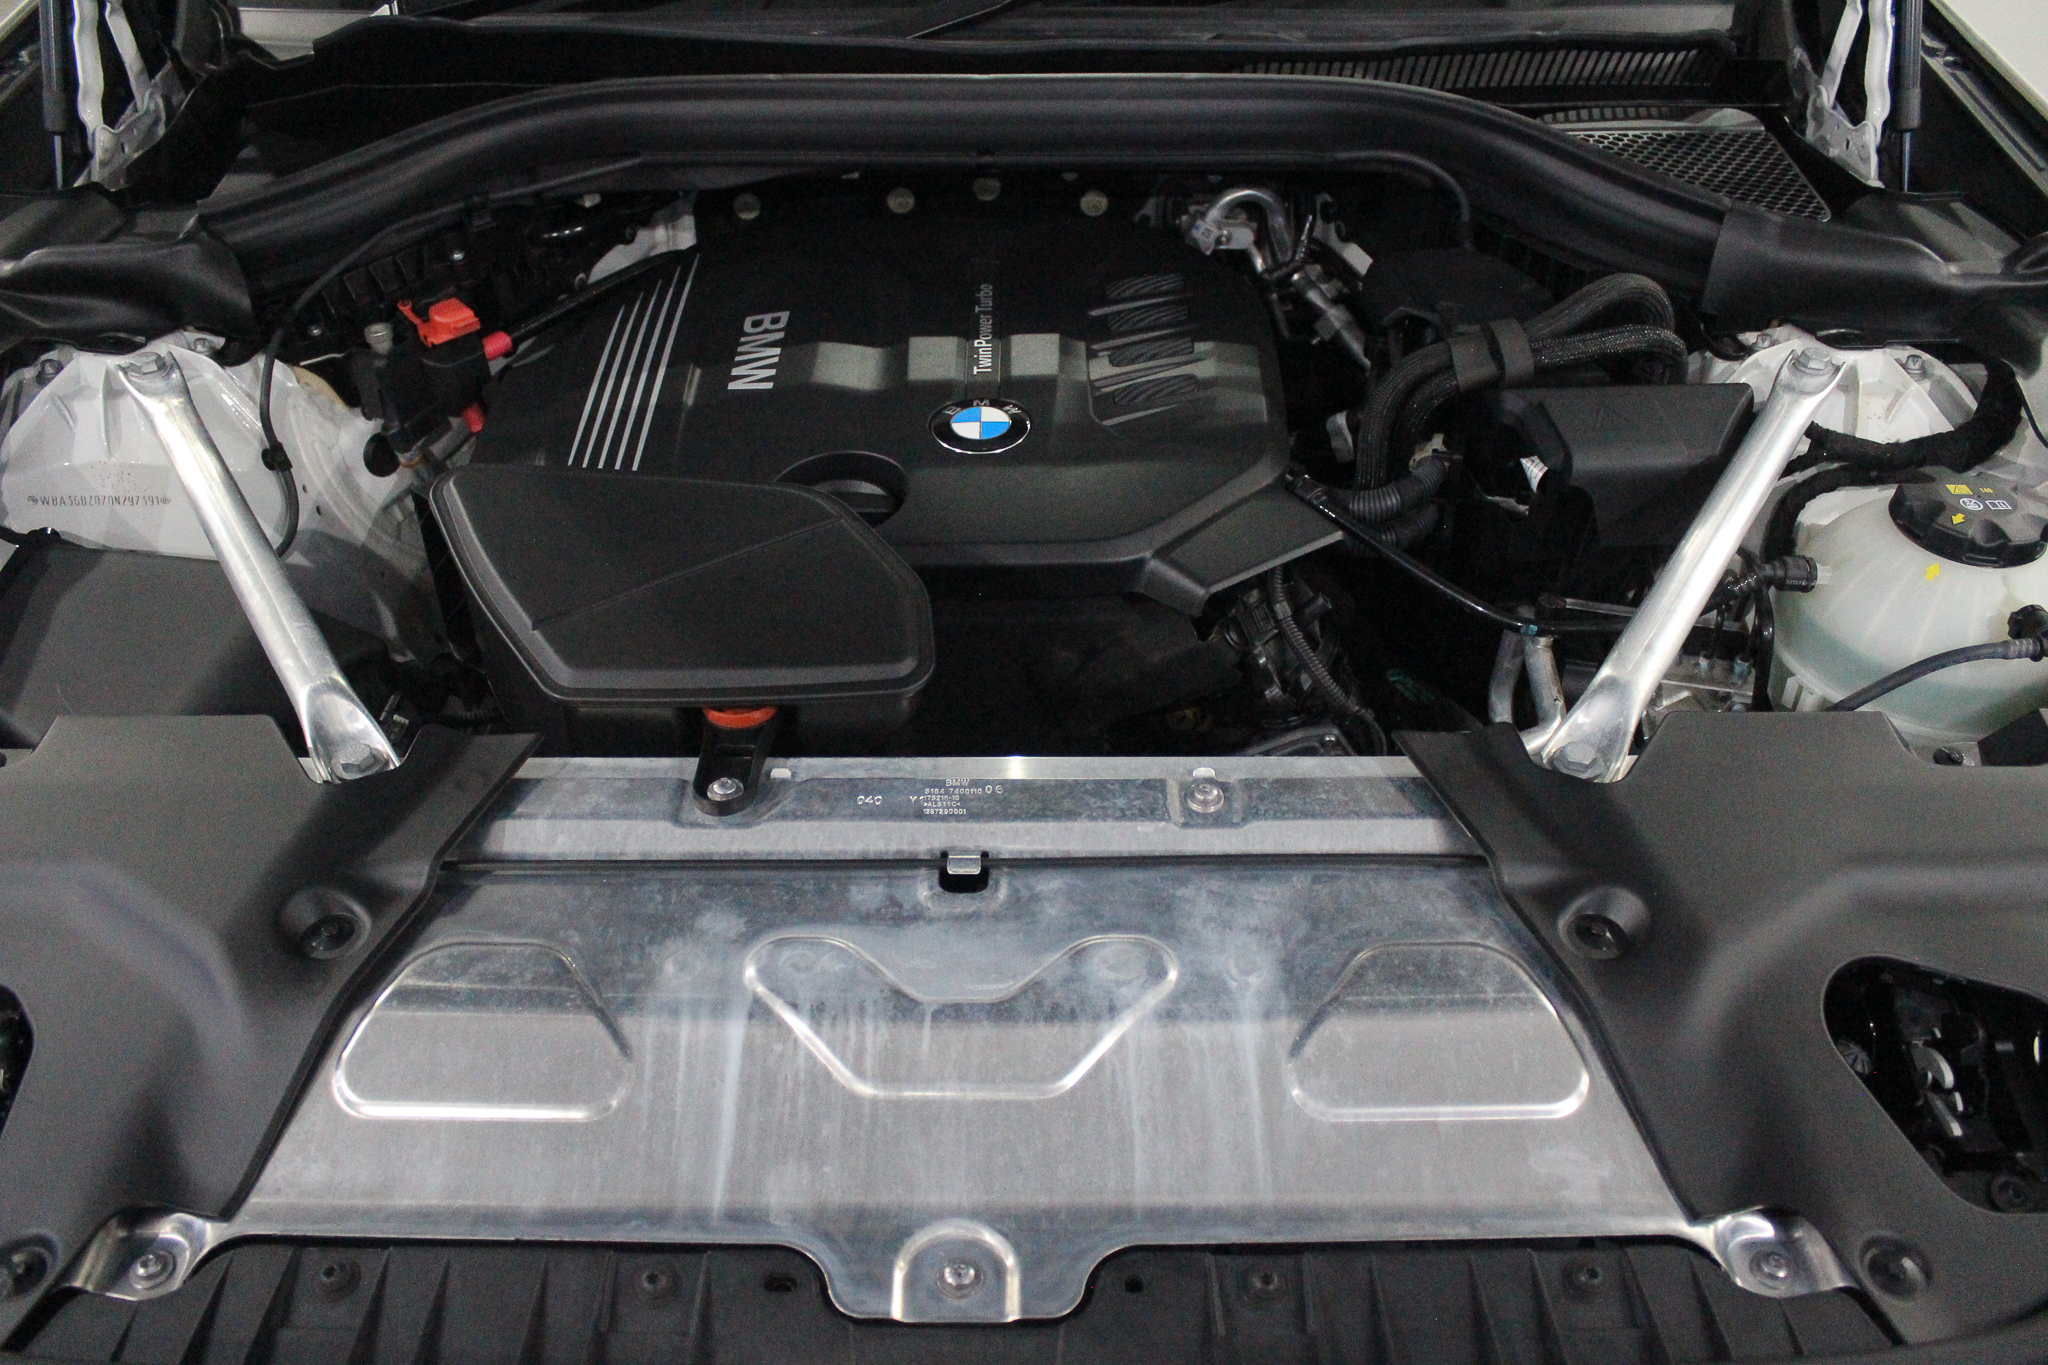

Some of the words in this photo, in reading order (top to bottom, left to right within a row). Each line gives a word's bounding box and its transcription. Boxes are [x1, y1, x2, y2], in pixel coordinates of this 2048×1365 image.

[975, 283, 993, 313] Turbo
[727, 310, 790, 390] BMW
[973, 315, 993, 375] TwinPower
[944, 399, 1022, 415] BMW
[945, 779, 970, 787] BMW
